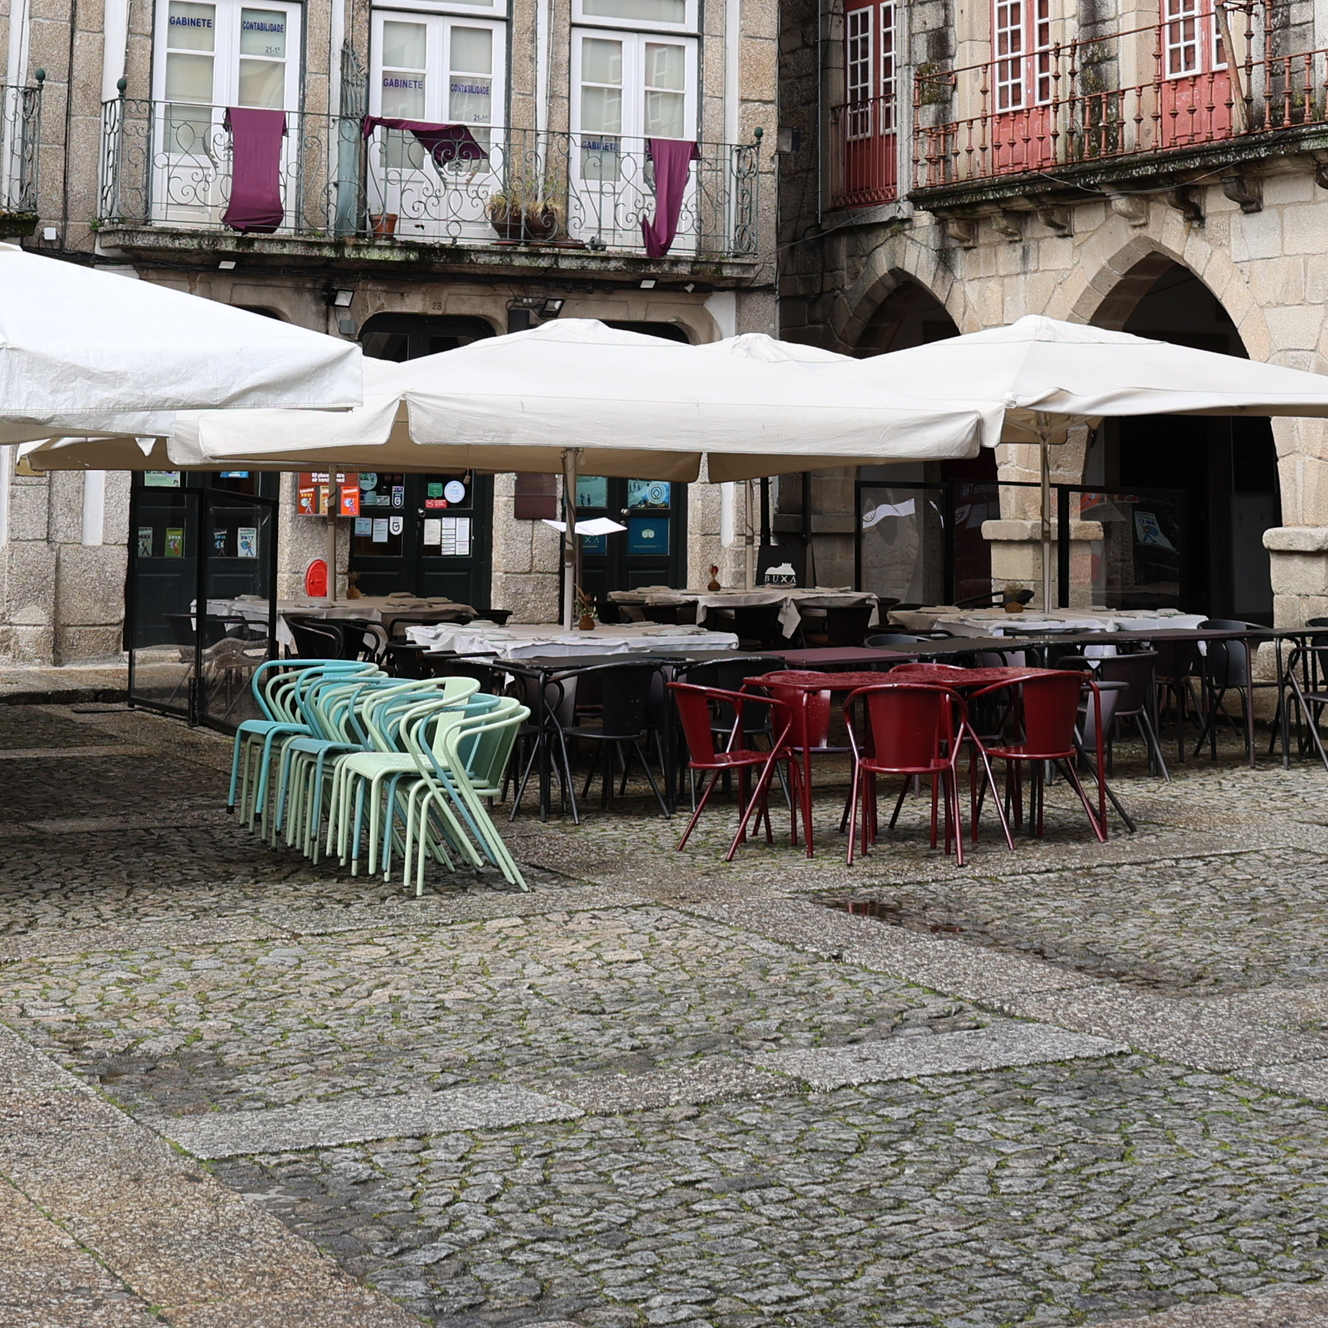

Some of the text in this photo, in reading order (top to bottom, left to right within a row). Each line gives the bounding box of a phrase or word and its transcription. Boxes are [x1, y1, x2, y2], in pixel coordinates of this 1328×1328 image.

[169, 16, 284, 33] GABINETE CONTABILIDADE
[383, 78, 489, 96] GABINETE CONTABILIDADE
